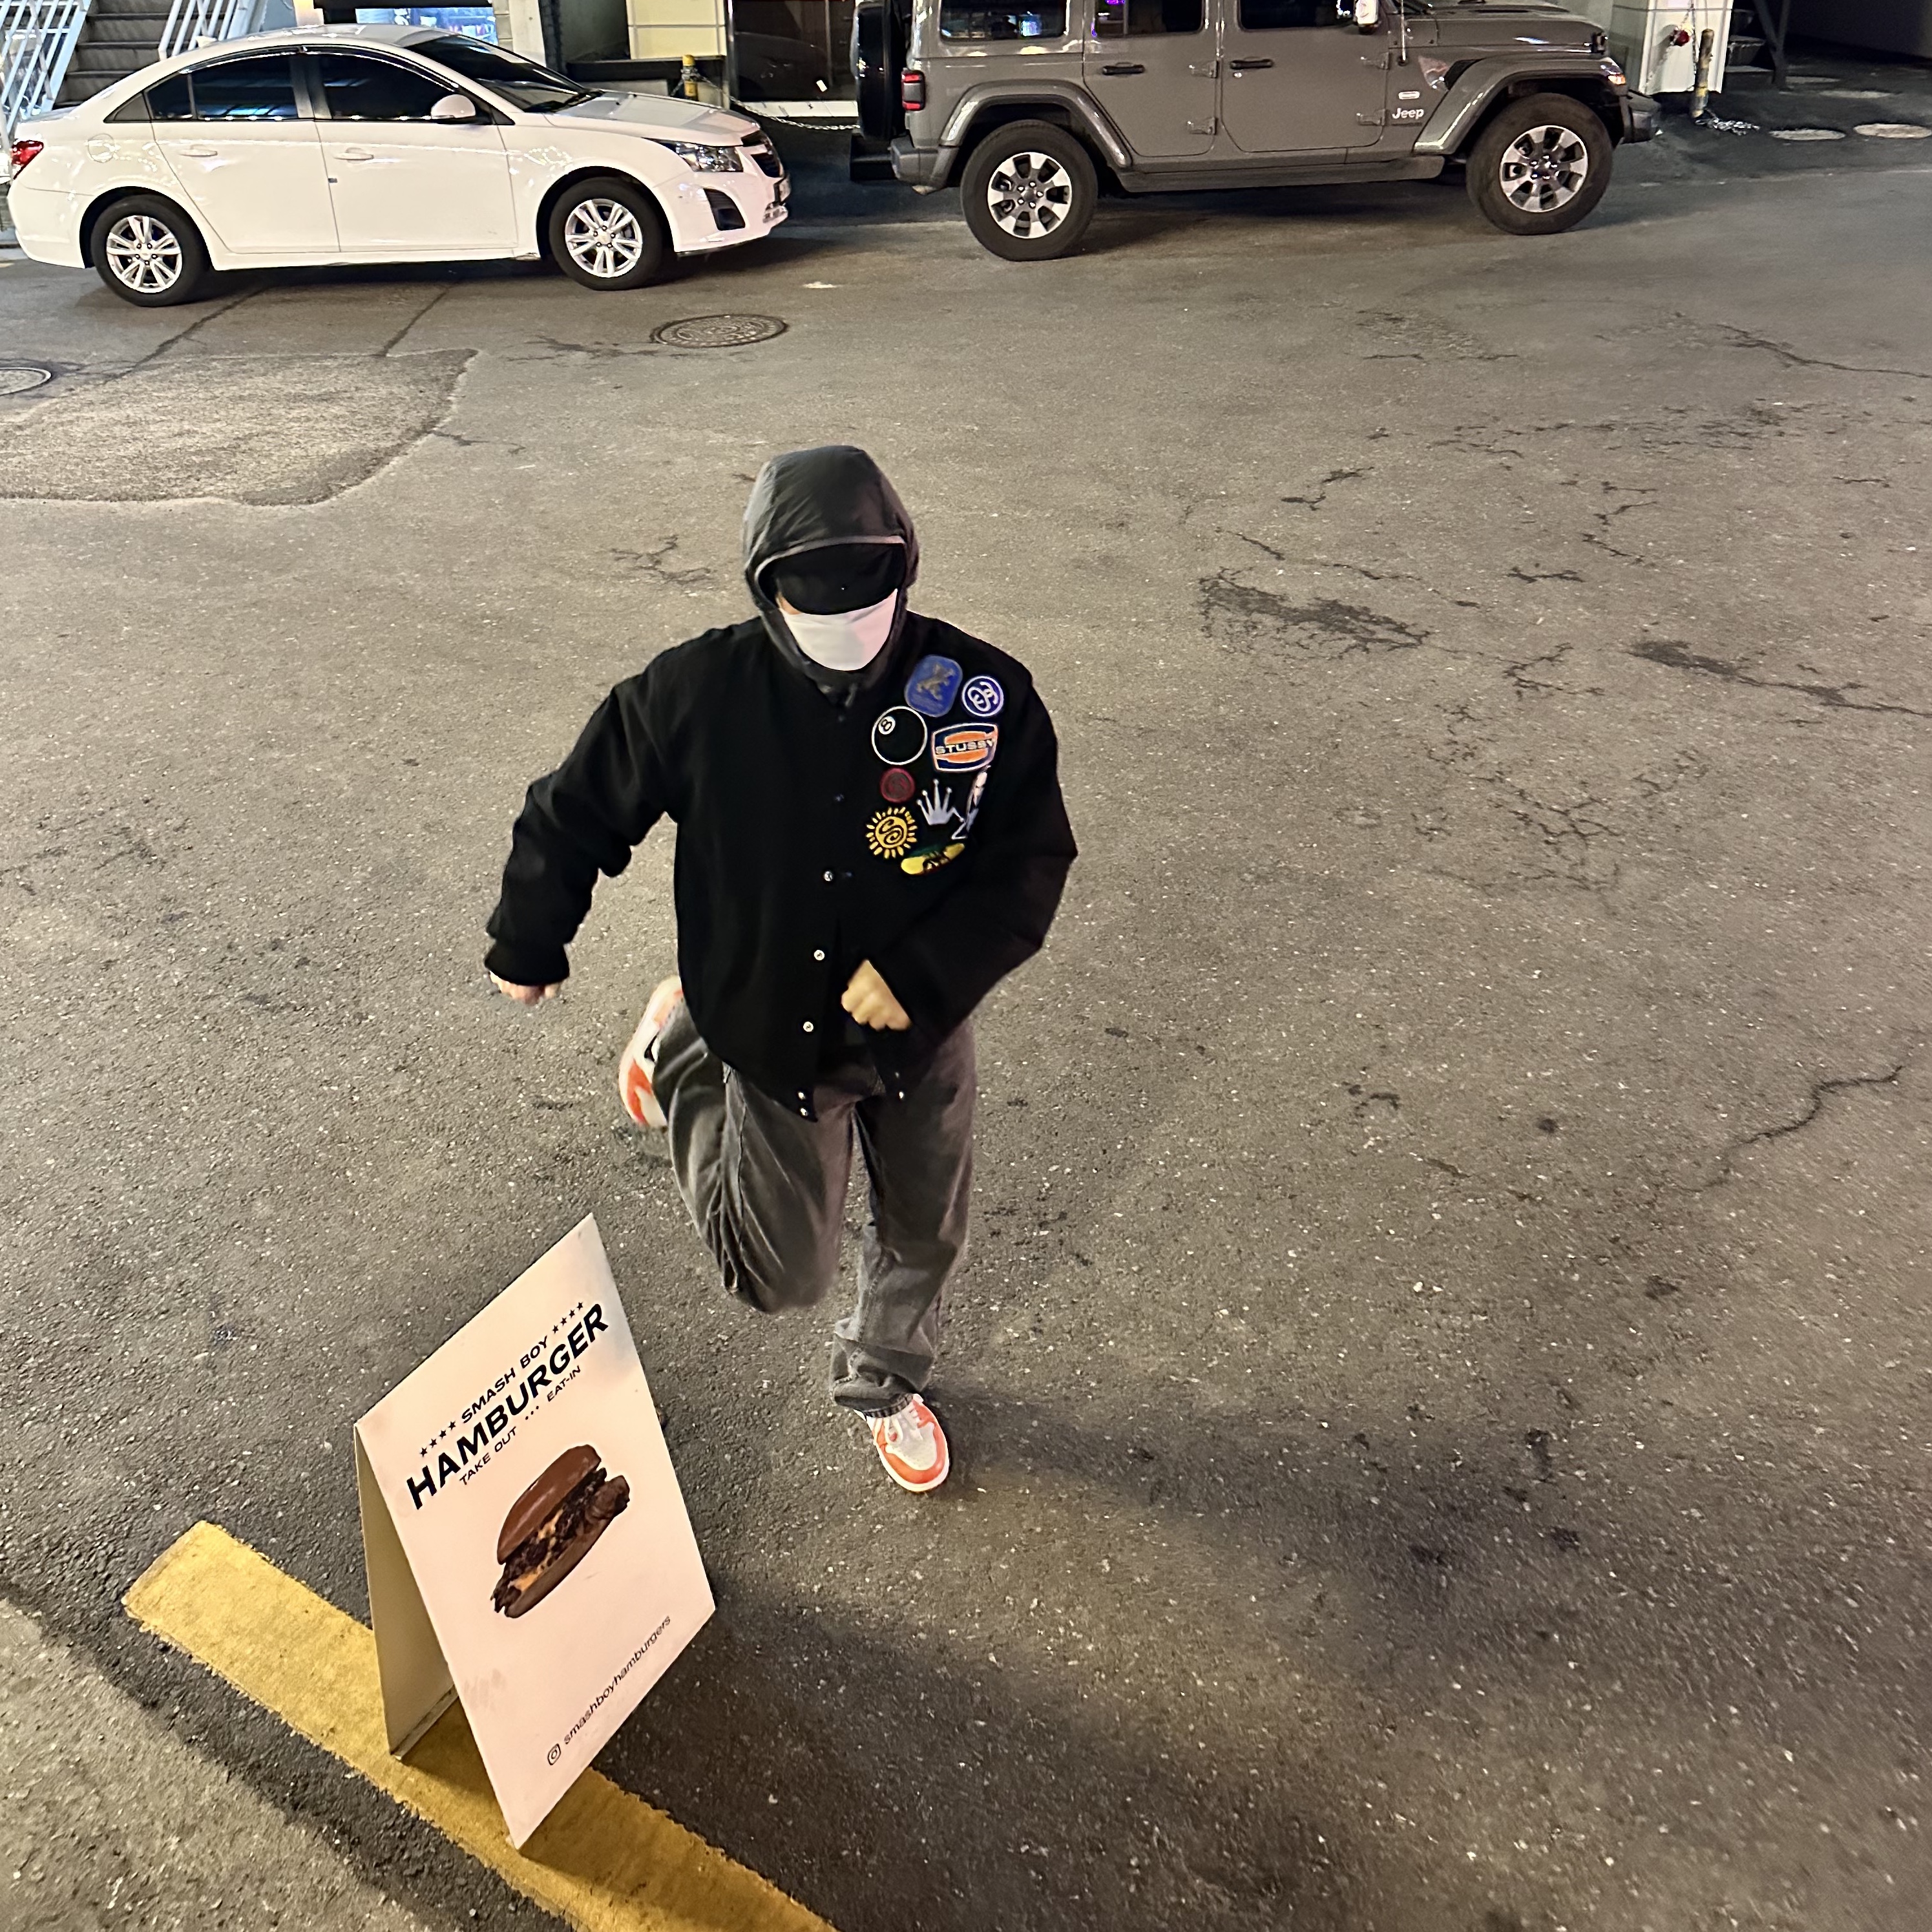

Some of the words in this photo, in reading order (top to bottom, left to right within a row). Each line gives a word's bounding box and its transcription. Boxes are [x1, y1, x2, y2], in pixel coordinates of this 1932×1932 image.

[1392, 107, 1424, 120] Jeep
[881, 719, 892, 732] 8
[406, 1303, 609, 1509] HAMBURGER
[459, 1453, 491, 1486] TAKE
[494, 1426, 517, 1453] OUT
[547, 1365, 581, 1402] EAT-IN
[461, 1367, 516, 1423] SMASH
[520, 1336, 547, 1369] BOY
[563, 1615, 671, 1745] smashboyhamburgers
